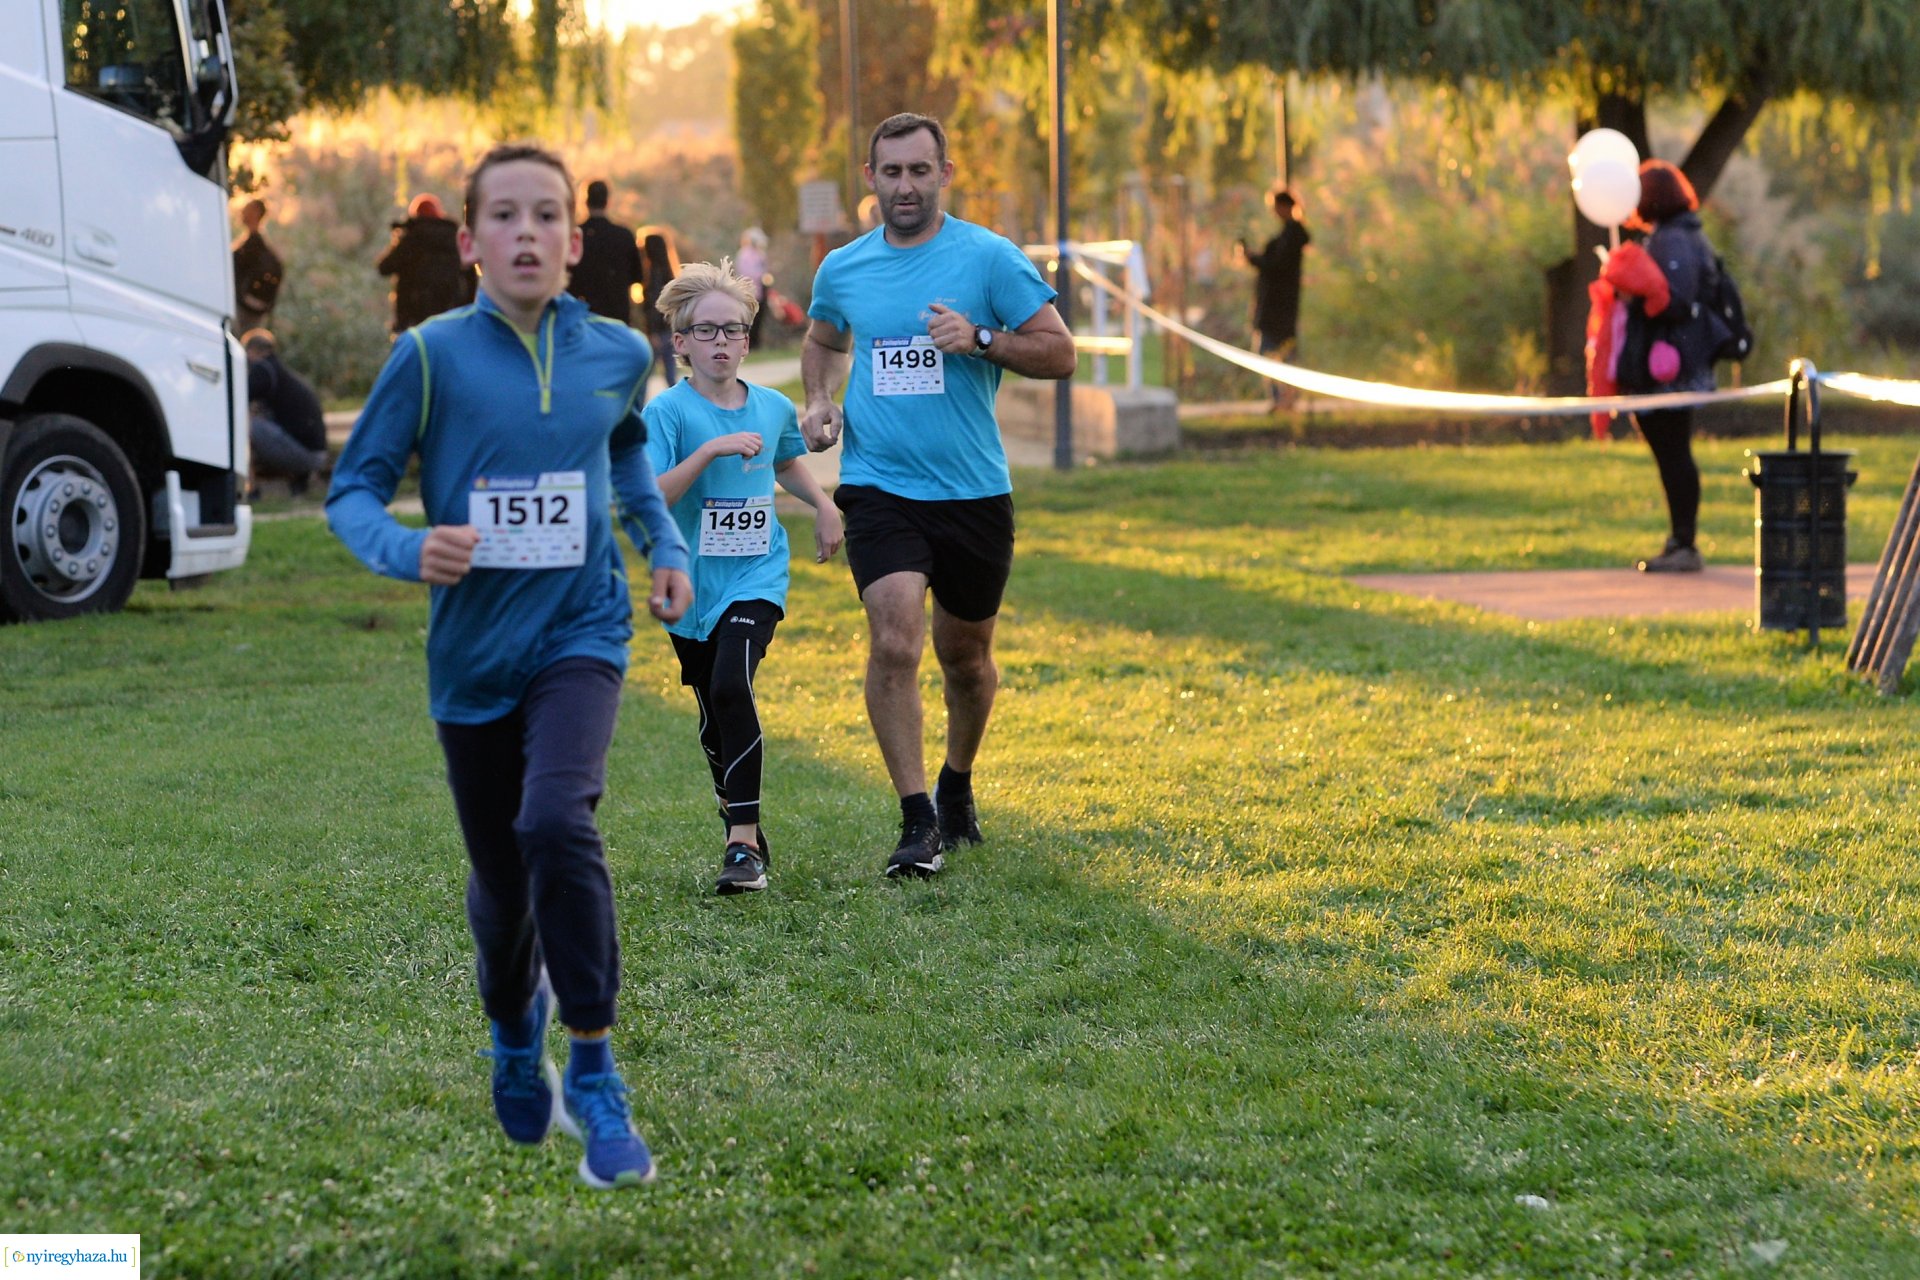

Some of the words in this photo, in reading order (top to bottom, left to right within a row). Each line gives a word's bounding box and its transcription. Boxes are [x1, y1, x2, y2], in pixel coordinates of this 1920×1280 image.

[20, 227, 55, 248] 460
[878, 349, 937, 369] 1498
[488, 495, 569, 526] 1512
[708, 510, 766, 530] 1499
